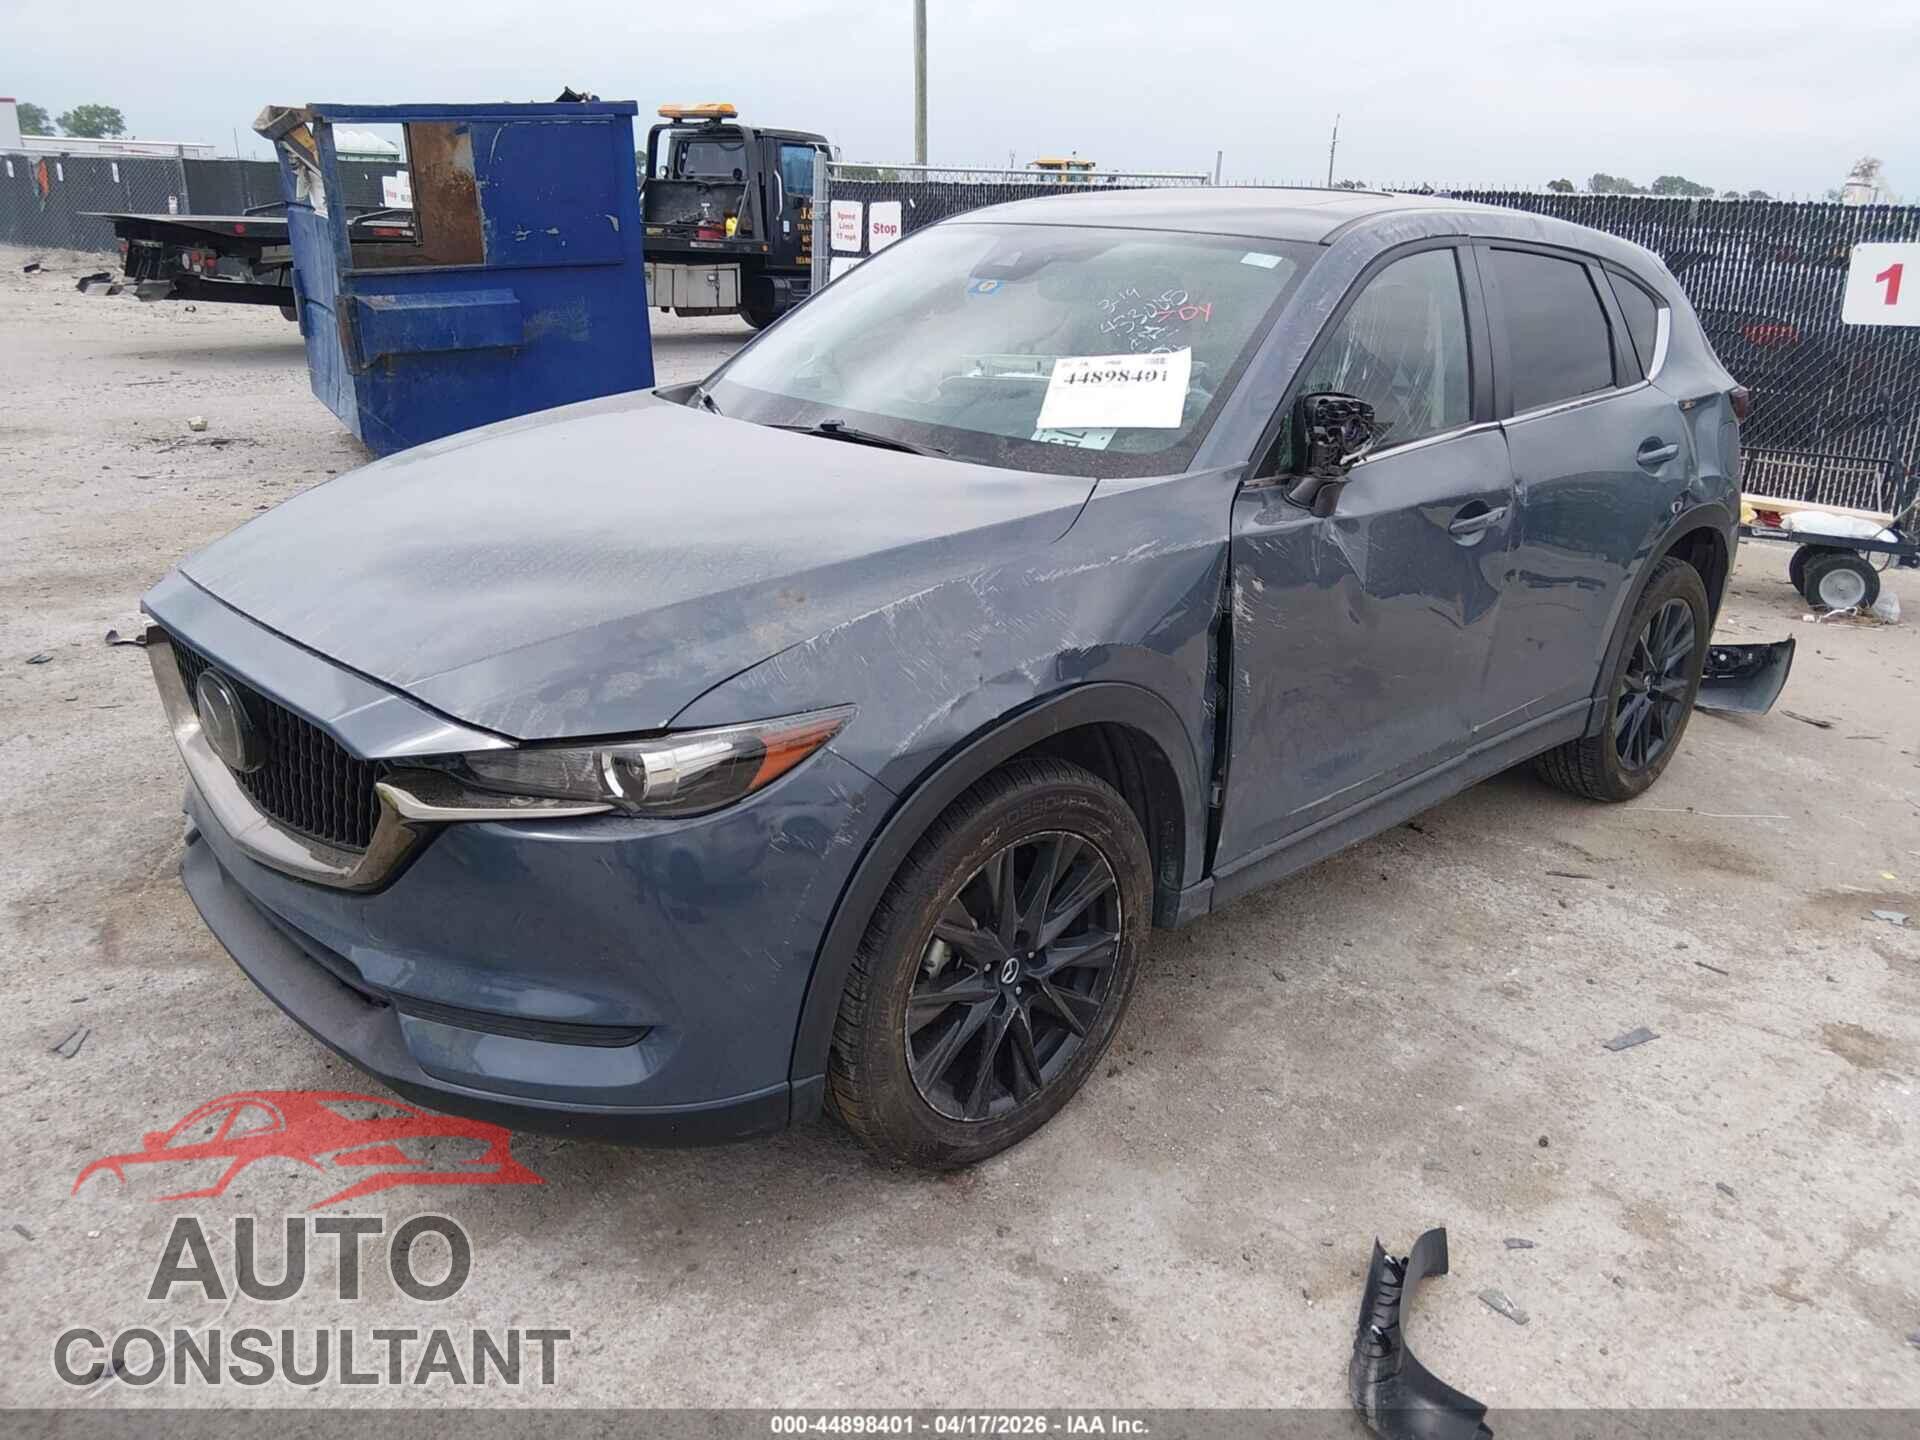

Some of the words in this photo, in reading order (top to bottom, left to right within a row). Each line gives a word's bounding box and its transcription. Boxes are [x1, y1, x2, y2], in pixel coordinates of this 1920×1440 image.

[873, 222, 897, 236] Stop
[1875, 263, 1904, 305] 1
[1064, 370, 1168, 385] 44898401
